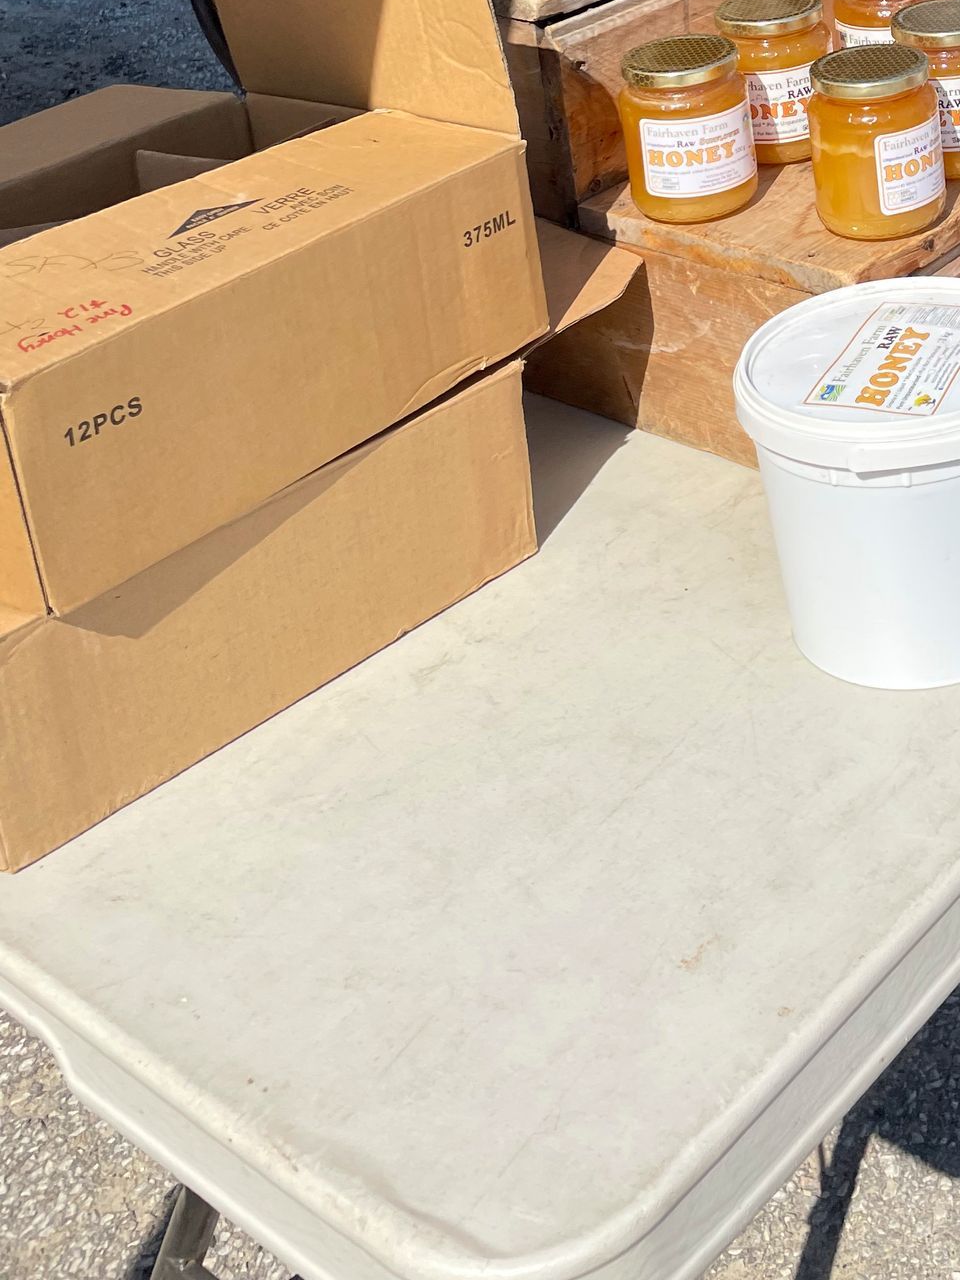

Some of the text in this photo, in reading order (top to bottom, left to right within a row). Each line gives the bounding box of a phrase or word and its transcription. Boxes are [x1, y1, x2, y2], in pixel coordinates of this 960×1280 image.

[749, 80, 782, 92] haven
[787, 86, 812, 100] RAW
[647, 121, 728, 139] Fairhaven Farm
[883, 132, 930, 152] Fairhaven
[647, 139, 737, 168] HONEY
[252, 186, 317, 216] VERRE
[289, 194, 319, 211] AVEC
[262, 221, 281, 232] CE
[310, 200, 328, 211] EN
[463, 210, 517, 248] 375ML
[142, 250, 192, 275] HANDLE
[188, 239, 219, 257] WITH
[219, 225, 252, 242] CARE
[153, 230, 217, 259] GLASS
[151, 263, 184, 279] THIS
[212, 244, 228, 256] UP
[17, 324, 83, 353] Honey
[877, 326, 903, 349] RAW
[832, 325, 887, 382] Fairhaven Farm
[855, 326, 930, 406] HONEY
[64, 396, 143, 448] 12PCS
